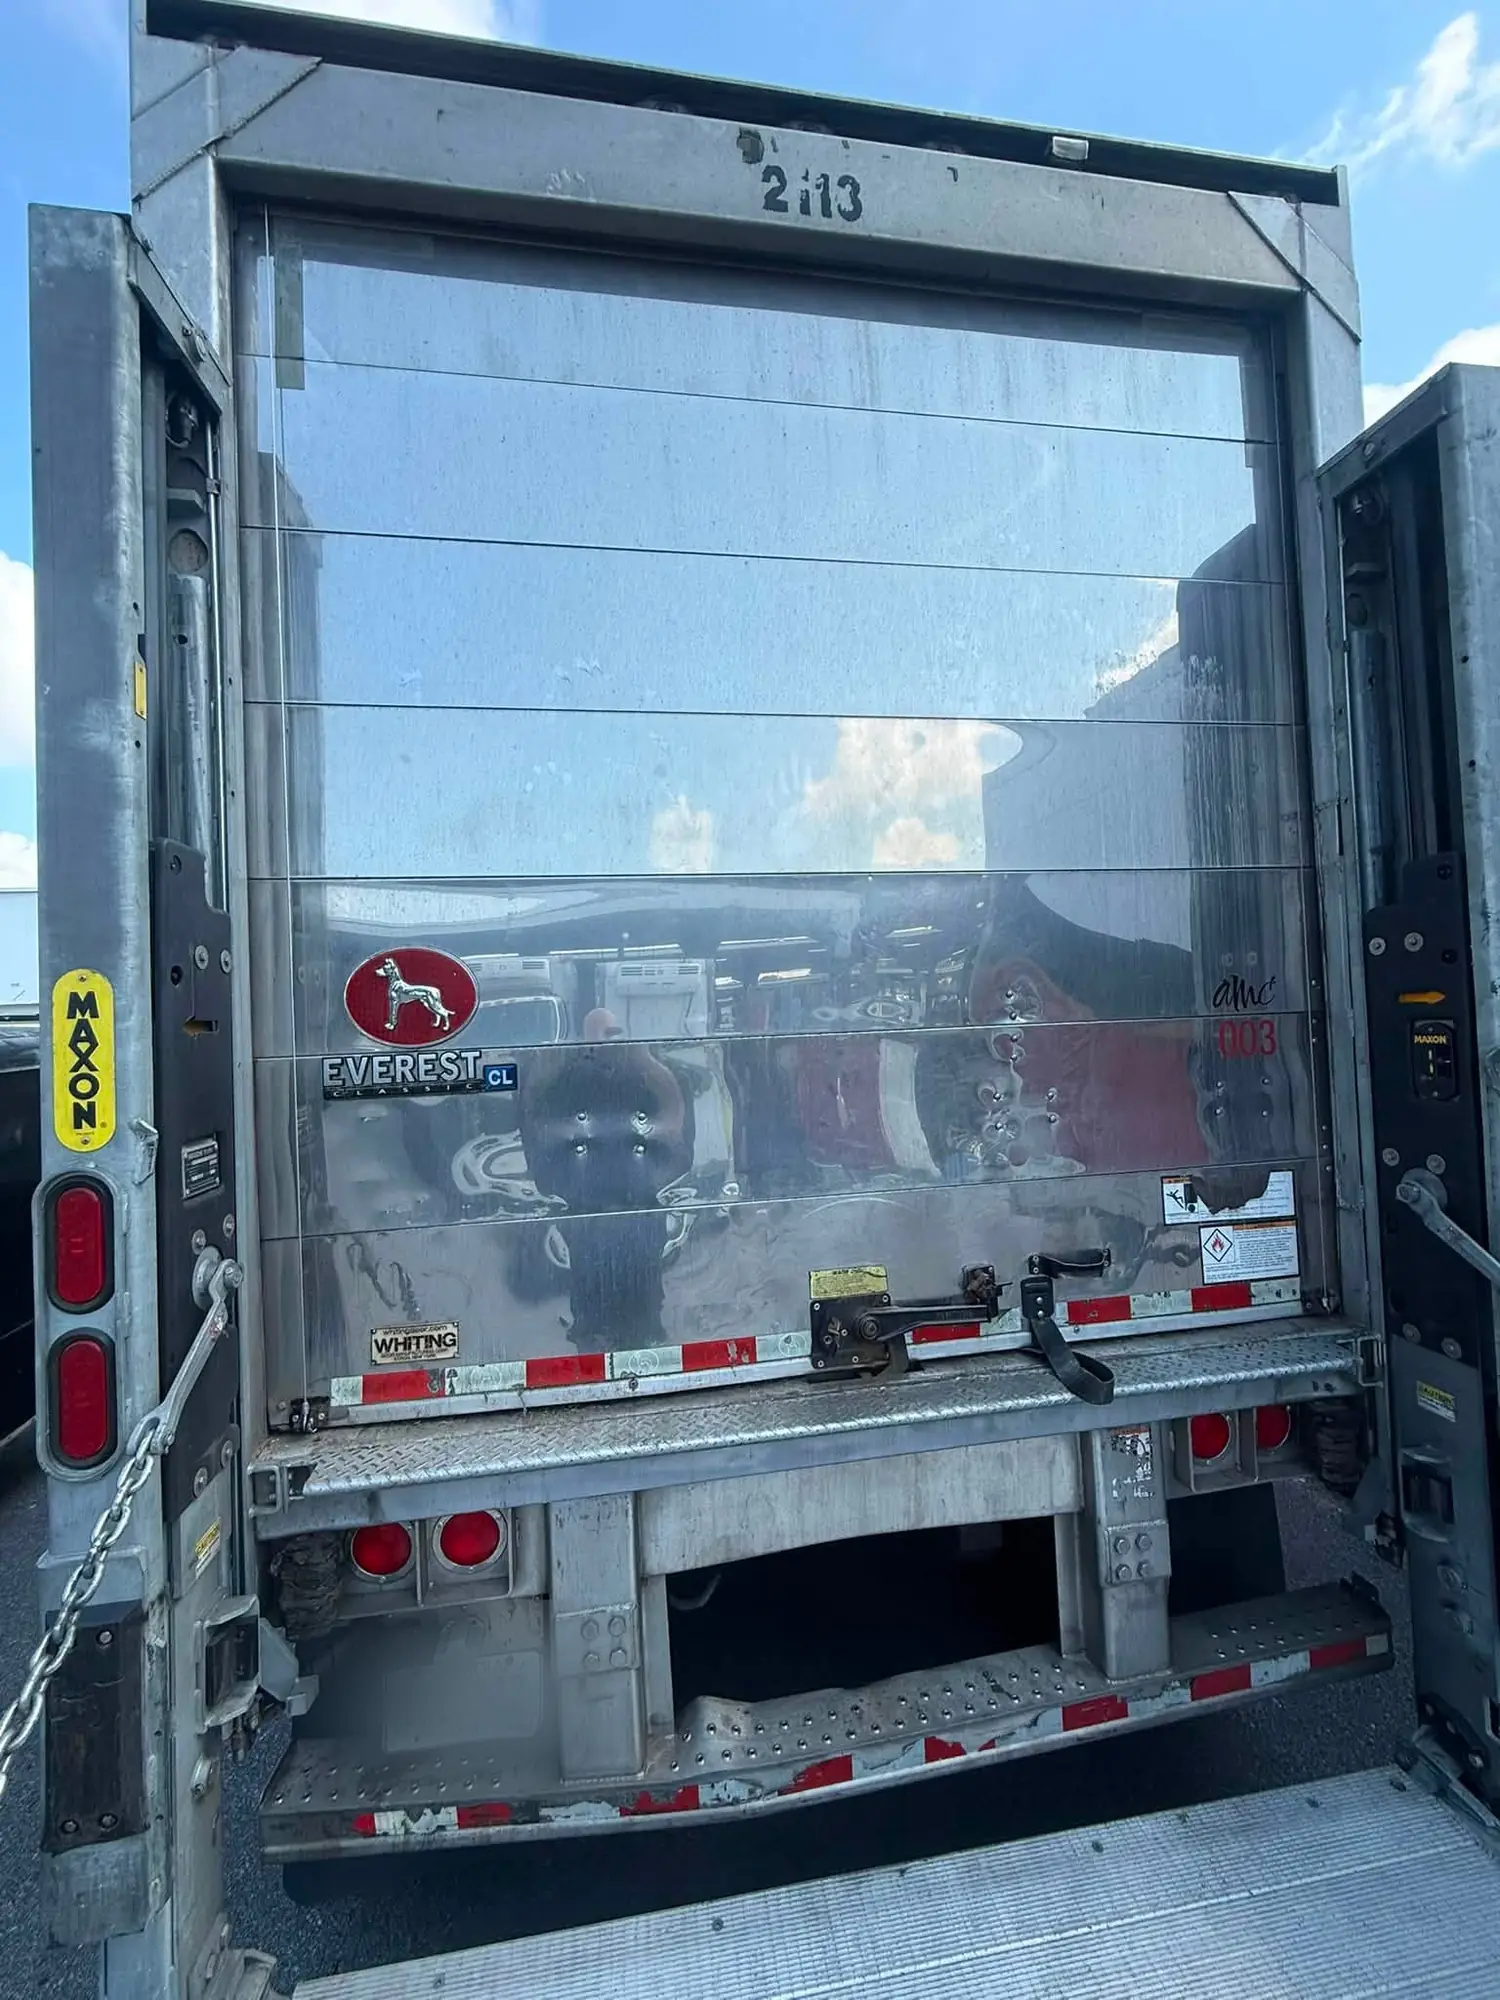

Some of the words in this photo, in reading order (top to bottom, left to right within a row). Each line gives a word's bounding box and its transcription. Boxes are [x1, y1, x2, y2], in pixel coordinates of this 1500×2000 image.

[1218, 1019, 1277, 1058] 003
[1414, 1034, 1447, 1045] MAXON
[67, 991, 100, 1130] MAXON
[322, 1050, 482, 1088] EVEREST
[487, 1068, 514, 1086] CL
[332, 1083, 473, 1098] CLASSIC
[373, 1332, 457, 1354] WHITING
